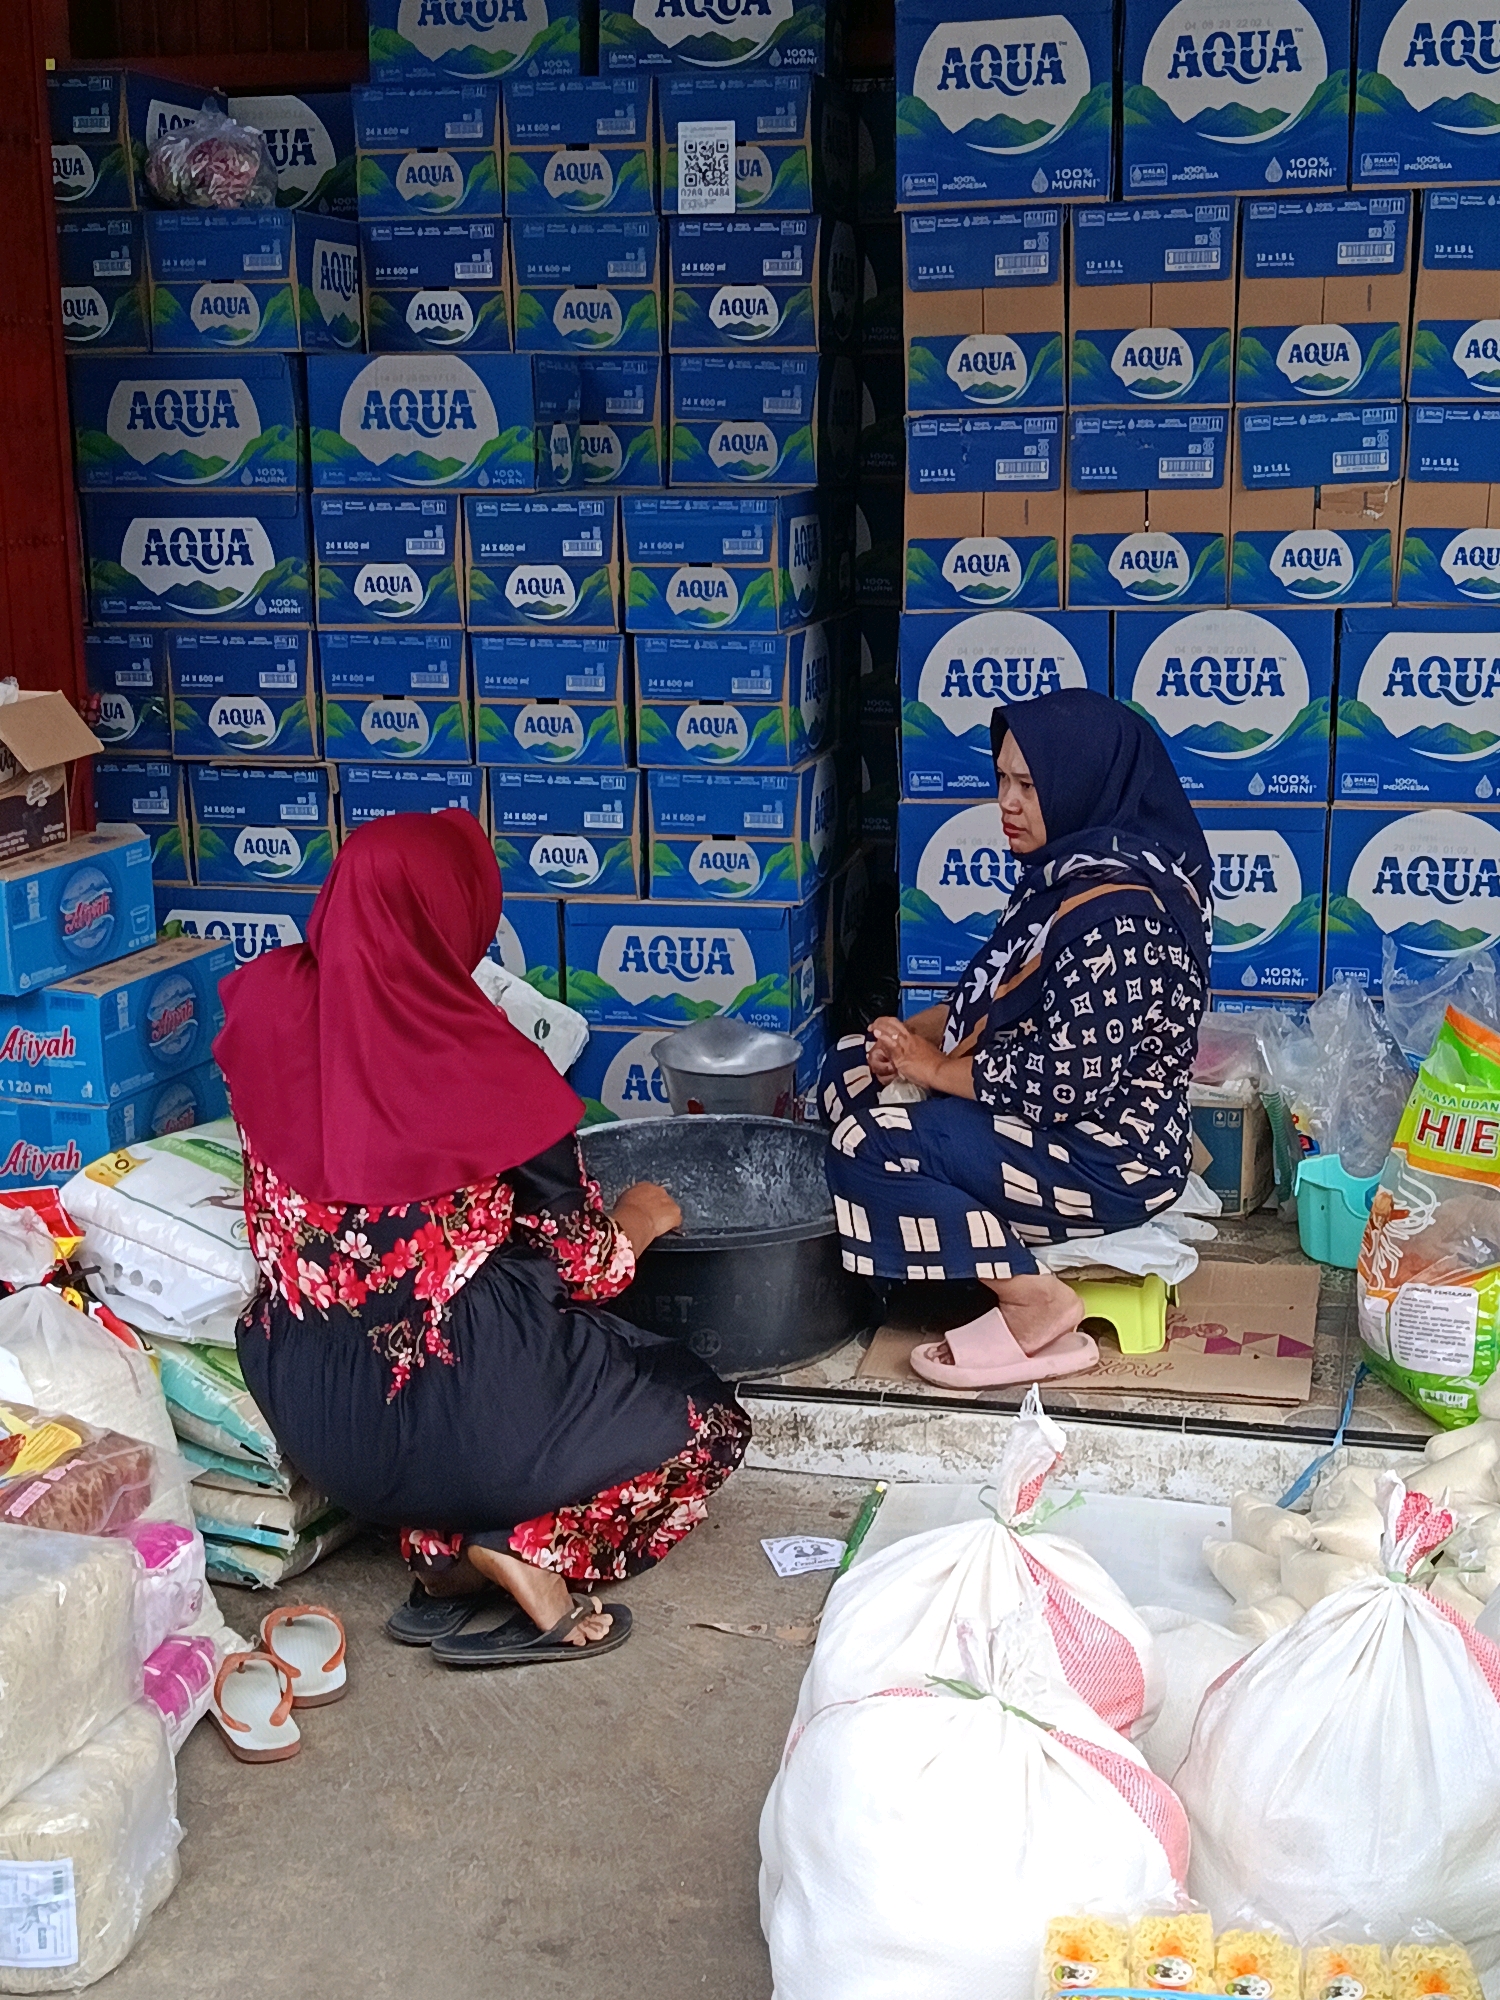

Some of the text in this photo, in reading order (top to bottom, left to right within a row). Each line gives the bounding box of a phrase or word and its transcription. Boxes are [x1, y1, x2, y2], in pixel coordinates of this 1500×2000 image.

[1167, 29, 1302, 84] AQUA
[937, 42, 1066, 96] AQUA
[264, 127, 316, 178] UA
[1290, 157, 1329, 169] 100%
[52, 157, 84, 178] QUA
[406, 165, 455, 186] AQUA
[554, 163, 603, 184] AQUA
[735, 159, 764, 181] UA
[1055, 168, 1093, 180] 100%
[1286, 168, 1333, 180] MURNI
[1052, 177, 1097, 190] MURNI
[64, 299, 98, 320] QUA
[200, 296, 250, 318] AQUA
[415, 304, 464, 324] AQUA
[563, 302, 613, 323] AQUA
[719, 298, 769, 319] AQUA
[958, 352, 1016, 375] AQUA
[1122, 347, 1183, 370] AQUA
[1288, 343, 1350, 366] AQUA
[127, 389, 240, 437] AQUA
[361, 389, 477, 438] AQUA
[579, 437, 613, 456] QUA
[719, 434, 768, 455] AQUA
[142, 527, 254, 574] AQUA
[1281, 548, 1342, 570] AQUA
[953, 554, 1011, 576] AQUA
[1120, 550, 1179, 573] AQUA
[364, 575, 413, 596] AQUA
[515, 578, 565, 598] AQUA
[676, 579, 728, 601] AQUA
[270, 598, 298, 606] 100%
[941, 657, 1062, 705] AQUA
[1156, 656, 1285, 706] AQUA
[101, 704, 125, 721] UA
[218, 709, 265, 728] AQUA
[371, 711, 419, 733] AQUA
[523, 716, 574, 737] AQUA
[686, 717, 738, 738] AQUA
[1268, 784, 1314, 794] MURNI
[1272, 774, 1310, 785] 100%
[243, 837, 291, 858] AQUA
[539, 848, 588, 868] AQUA
[699, 852, 750, 873] AQUA
[1211, 854, 1278, 900] UA
[1372, 856, 1500, 905] AQUA
[619, 935, 735, 982] AQUA
[1260, 976, 1306, 987] MURNI
[1264, 967, 1302, 978] 100%
[0, 1026, 75, 1066] Afiyah
[8, 1080, 31, 1093] 120
[0, 1141, 80, 1179] Afiyah
